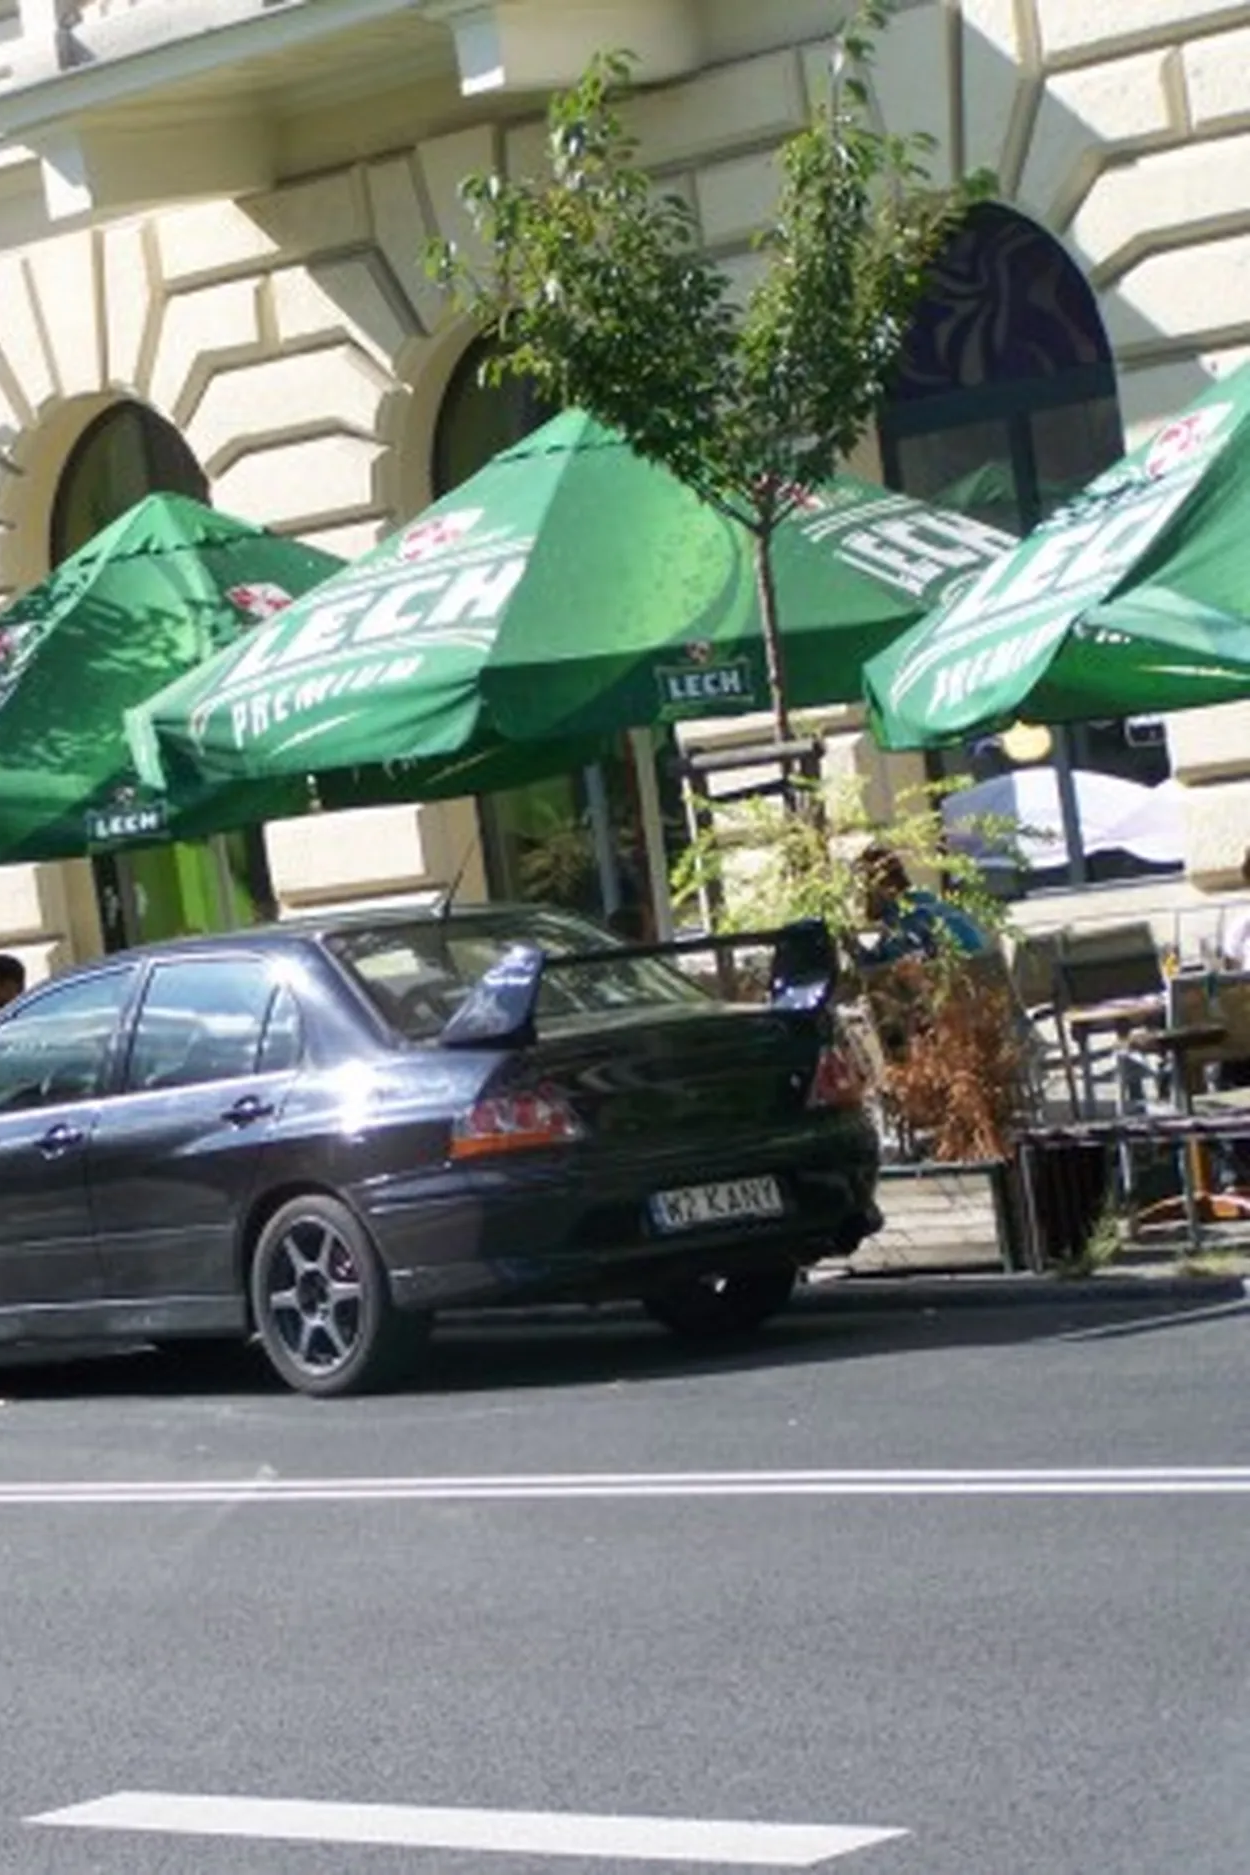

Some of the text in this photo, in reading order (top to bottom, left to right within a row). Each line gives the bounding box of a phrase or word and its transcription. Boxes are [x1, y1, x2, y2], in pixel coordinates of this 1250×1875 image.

[834, 510, 1022, 597] LECH
[219, 552, 529, 689] LECH
[667, 670, 741, 698] LECH
[95, 811, 159, 839] LECH
